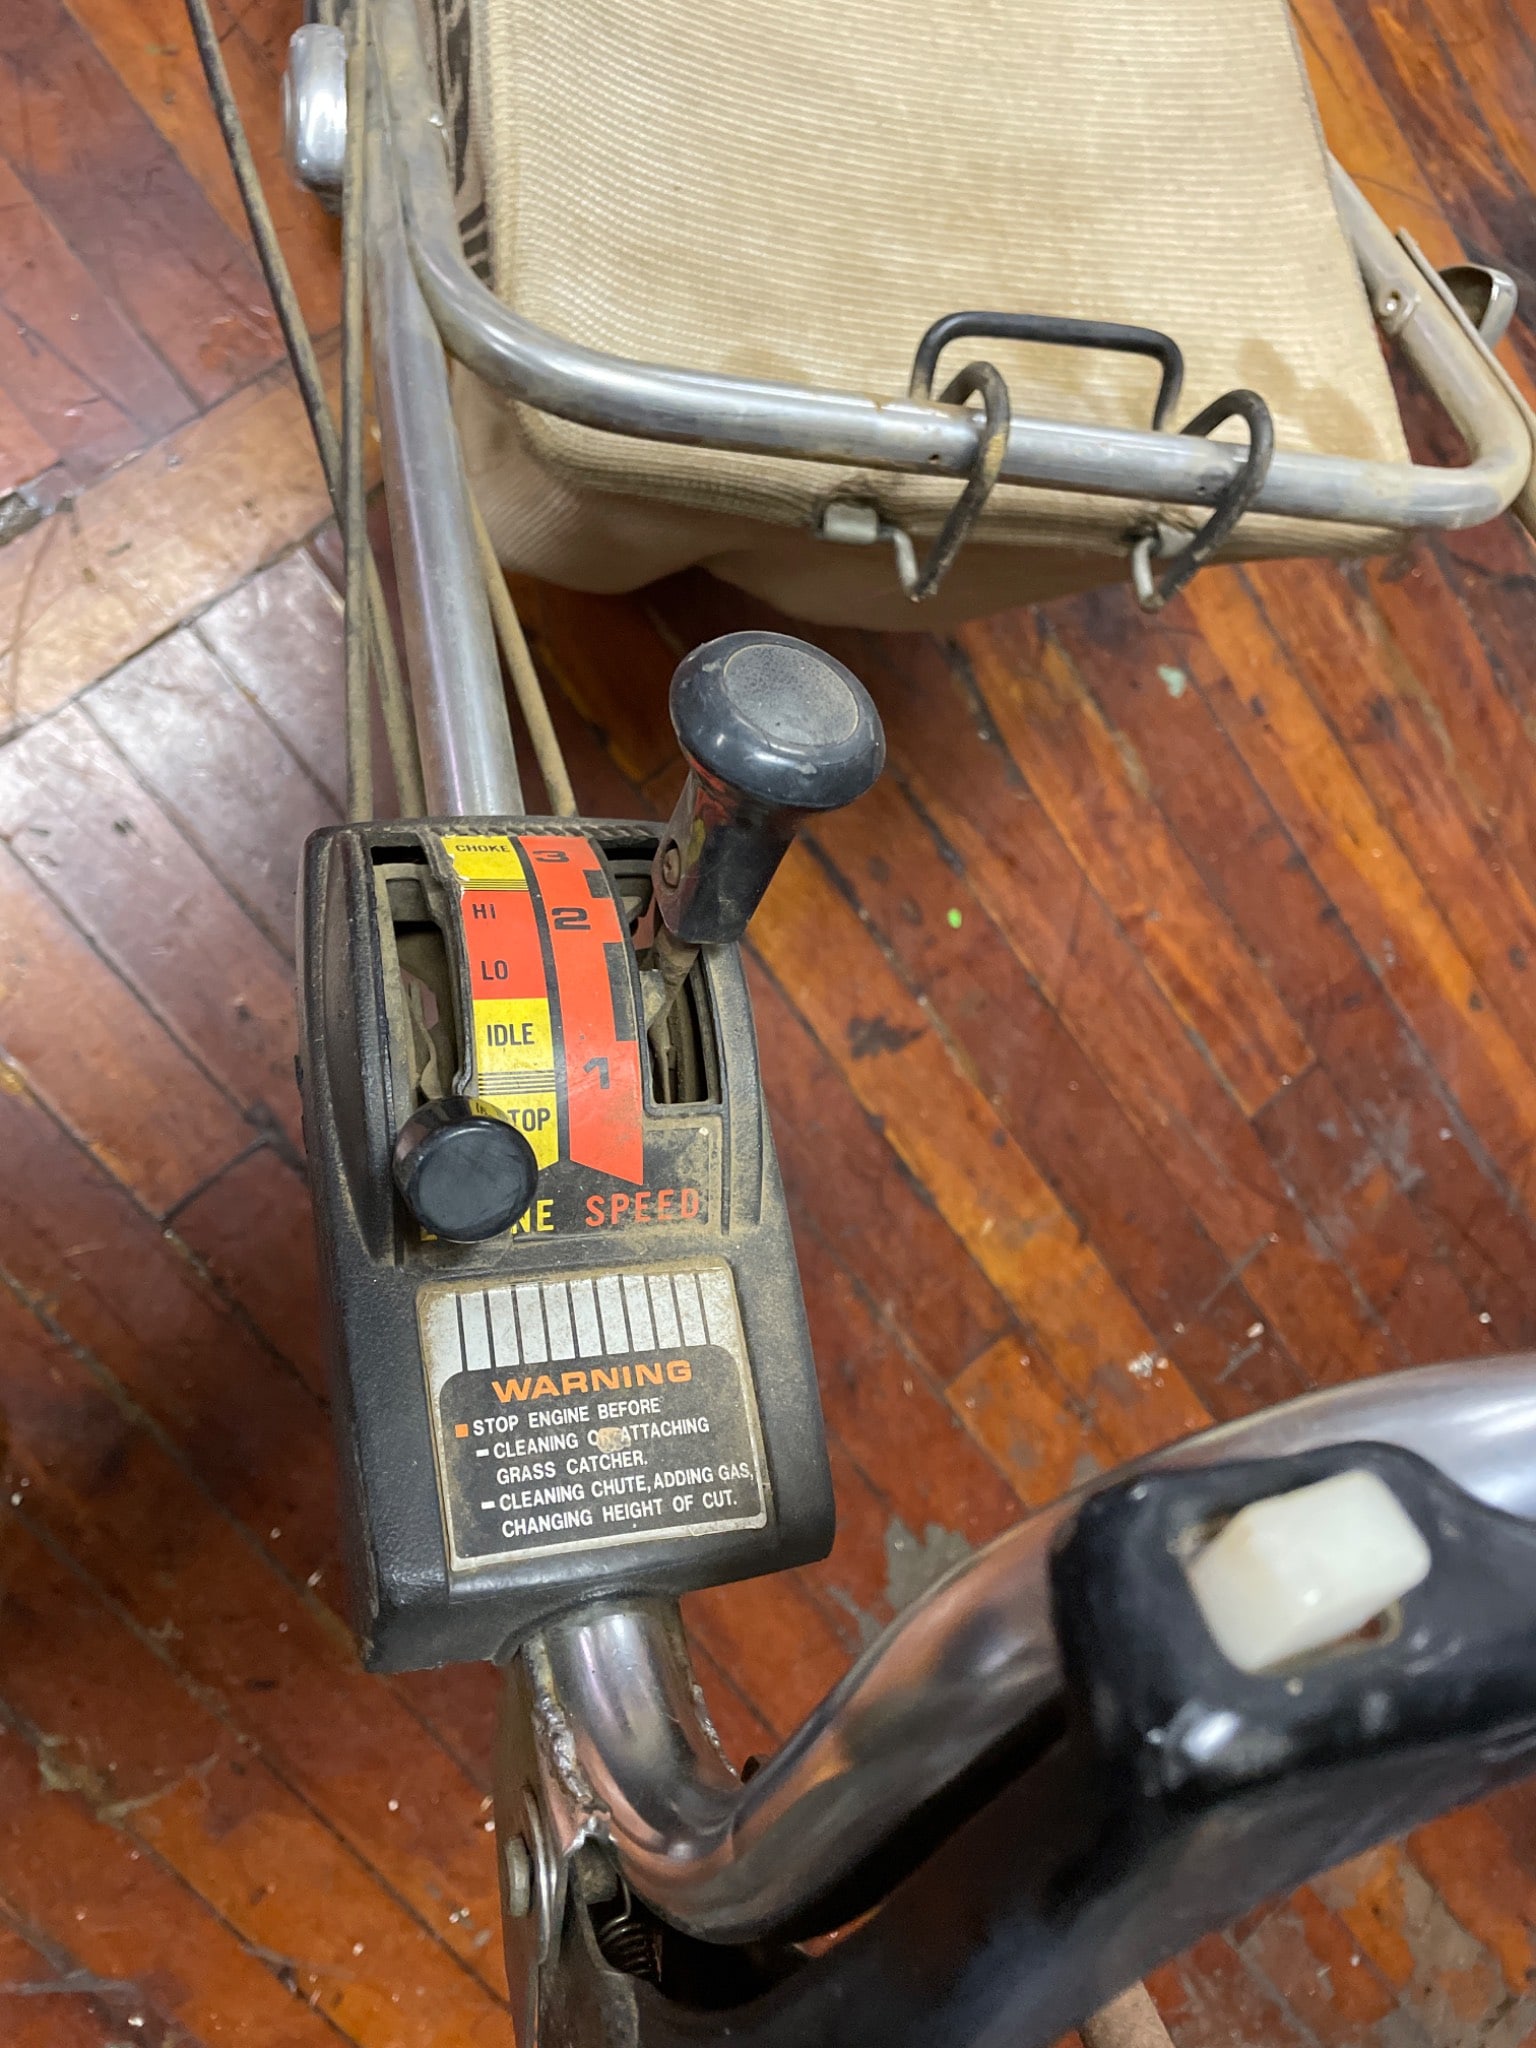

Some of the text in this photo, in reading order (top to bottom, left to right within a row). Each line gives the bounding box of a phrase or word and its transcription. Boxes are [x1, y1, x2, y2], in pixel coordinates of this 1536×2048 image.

[455, 843, 510, 853] CHOKE
[532, 850, 570, 863] 3
[472, 903, 496, 919] HI
[551, 907, 591, 930] 2
[481, 960, 508, 980] LO
[487, 1022, 535, 1047] IDLE
[583, 1057, 610, 1089] 1
[507, 1108, 551, 1132] TOP
[585, 1188, 700, 1227] SPEED
[491, 1359, 693, 1403] WARNING
[472, 1397, 662, 1437] STOP ENGINE BEFORE
[493, 1433, 579, 1460] CLEANING
[619, 1417, 710, 1443] ATTACHING
[496, 1450, 649, 1486] GRASS CATCHER.
[499, 1462, 755, 1512] CLEANING CHUTE, ADDING GAS,
[501, 1489, 738, 1539] CHANGING HEIGHT OF CUT.
